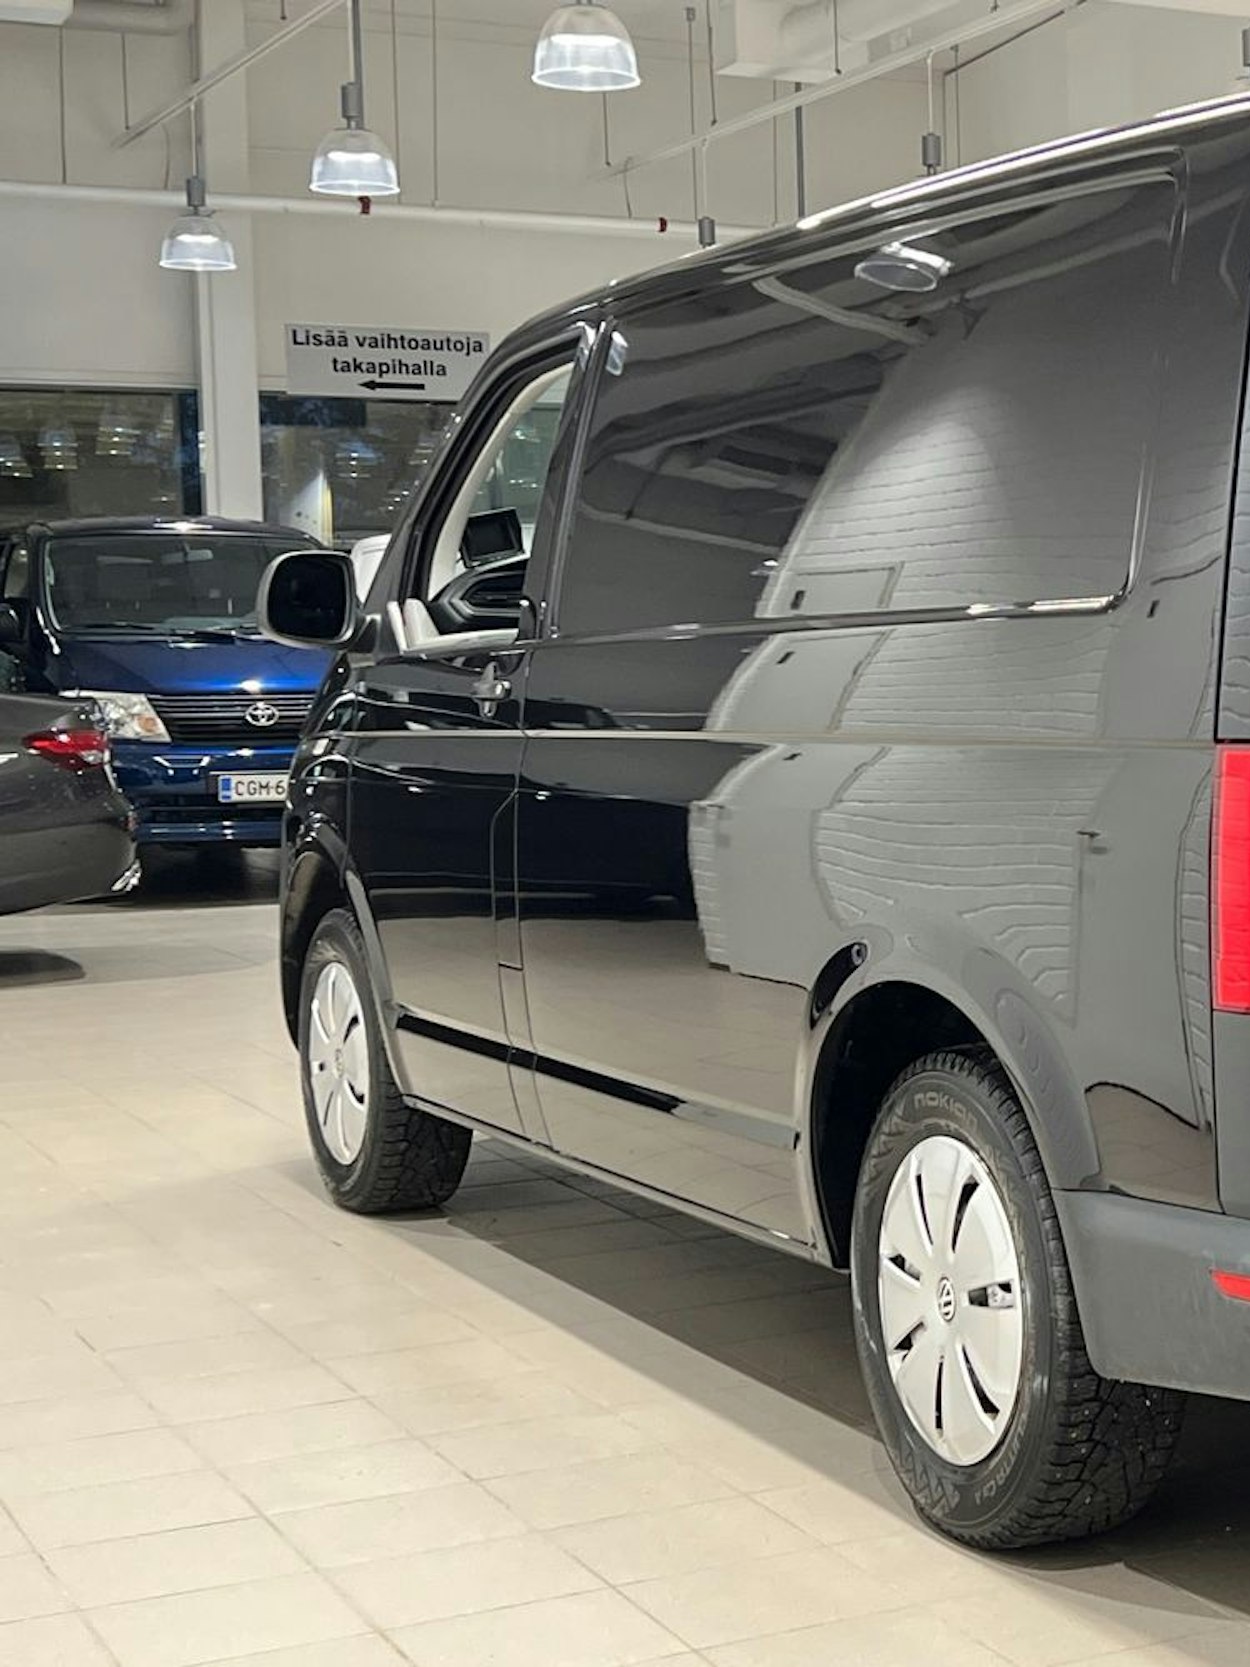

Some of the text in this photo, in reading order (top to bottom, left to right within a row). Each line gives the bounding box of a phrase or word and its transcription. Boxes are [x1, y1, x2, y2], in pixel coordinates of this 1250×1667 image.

[292, 329, 483, 356] Lisää vaihtoautoja
[332, 357, 447, 378] takapihalla
